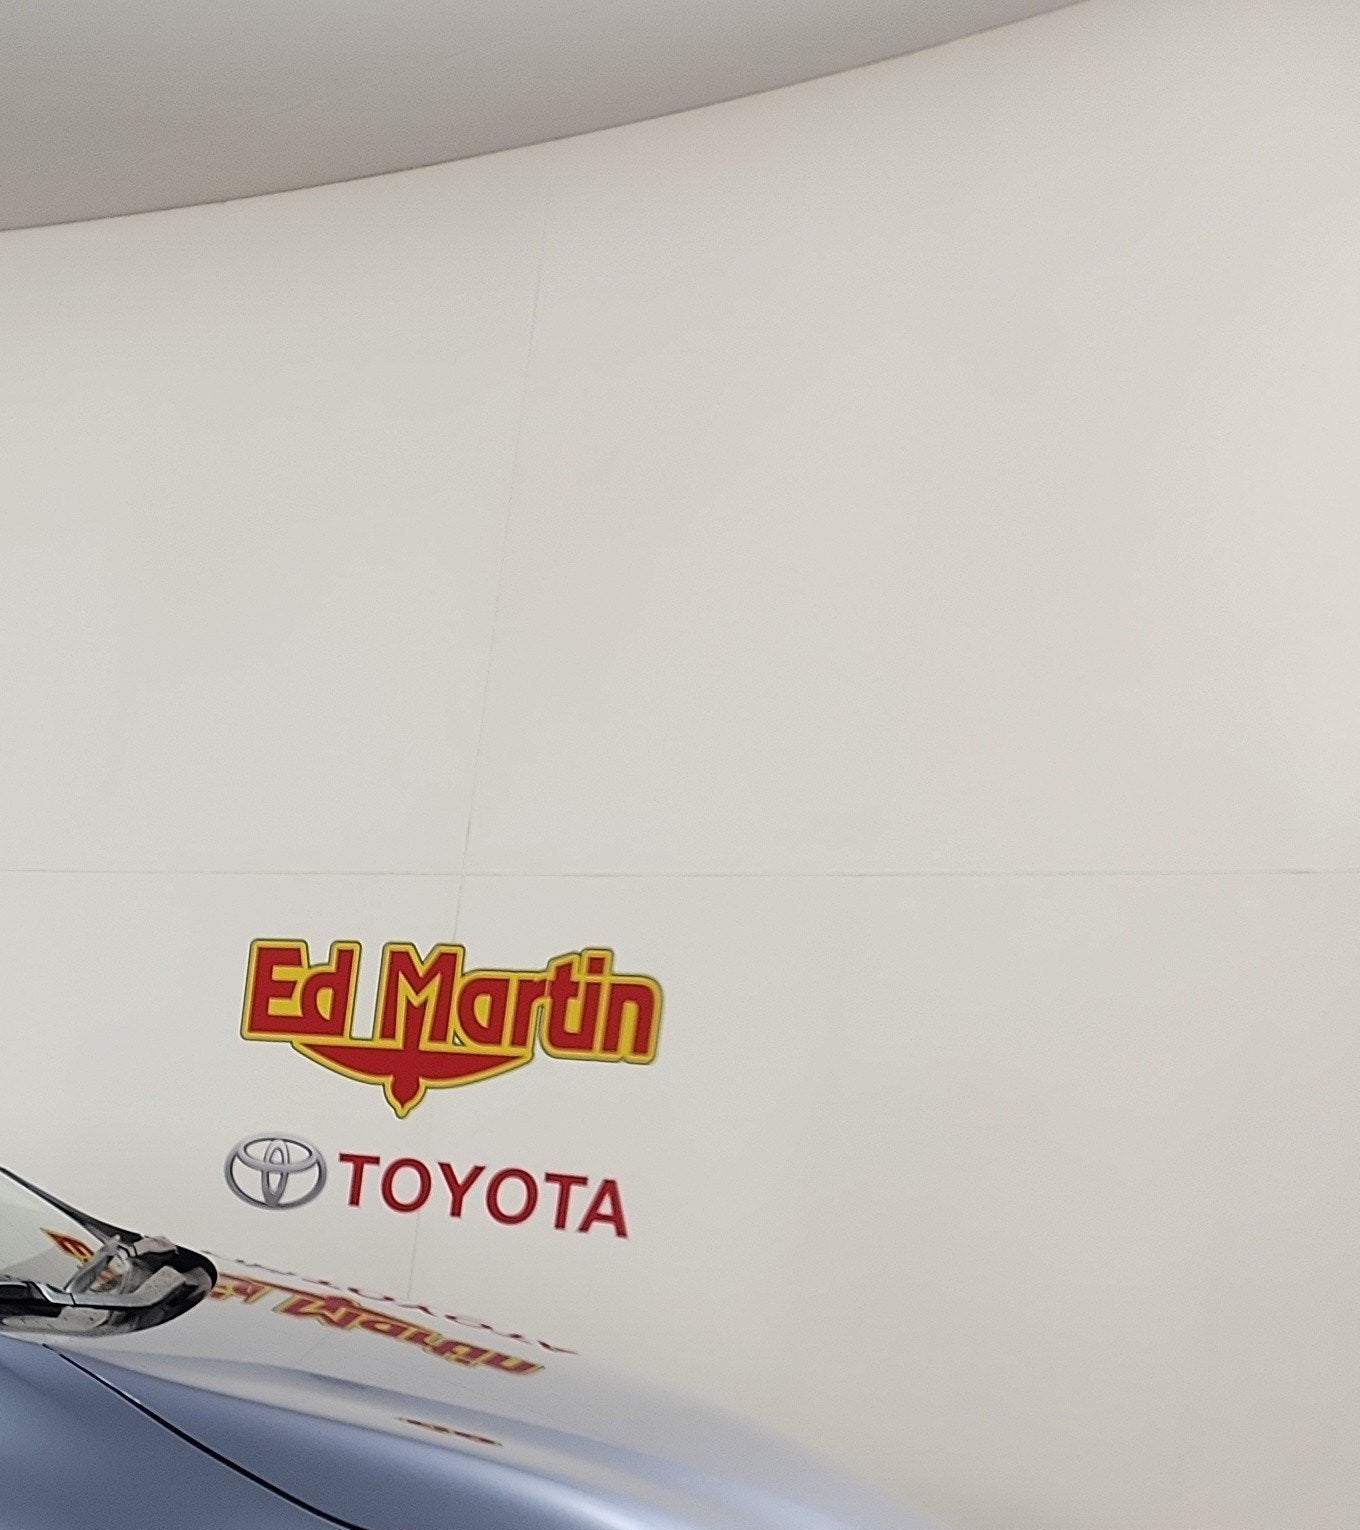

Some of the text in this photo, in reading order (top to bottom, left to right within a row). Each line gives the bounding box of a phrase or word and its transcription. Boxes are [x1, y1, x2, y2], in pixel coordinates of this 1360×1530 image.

[248, 946, 656, 1055] Ed Martin
[339, 1153, 628, 1238] TOYOTA
